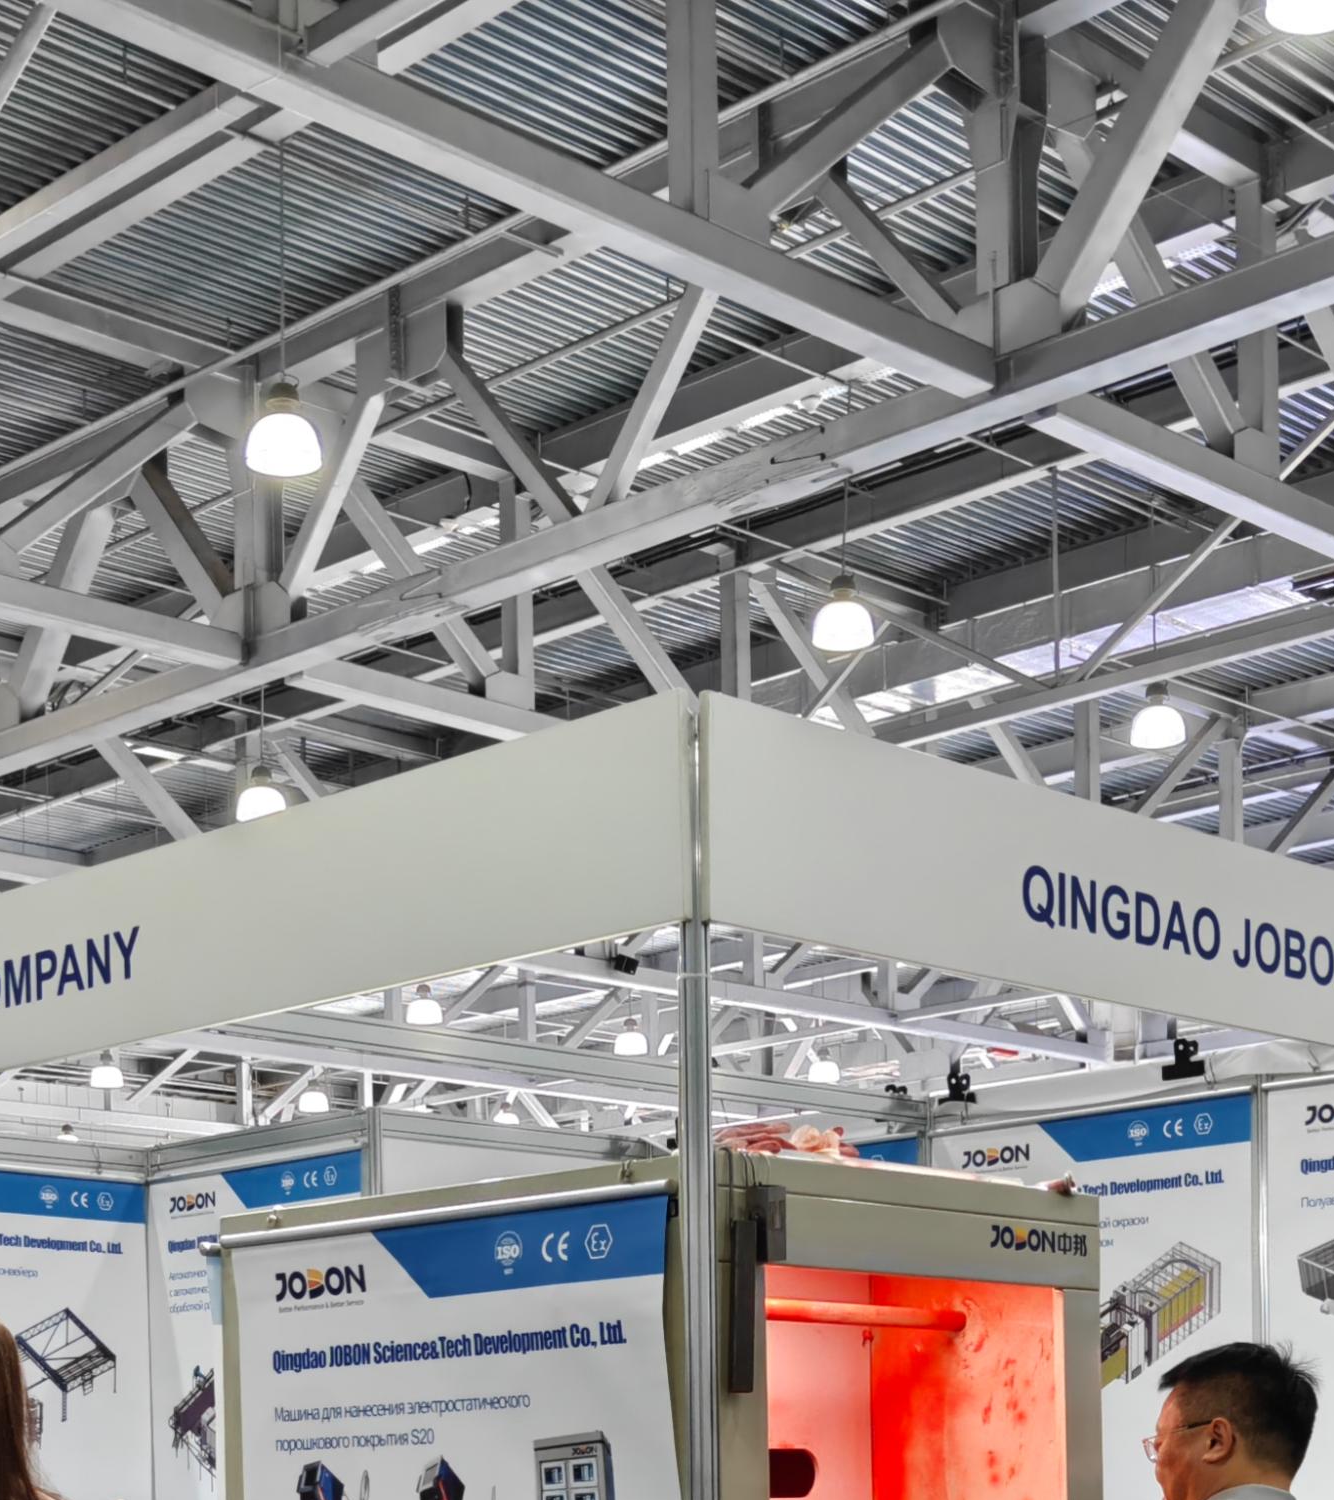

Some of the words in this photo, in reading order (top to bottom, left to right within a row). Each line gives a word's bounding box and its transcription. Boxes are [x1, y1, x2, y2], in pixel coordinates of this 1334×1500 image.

[1021, 864, 1221, 960] QINGDAO
[961, 1143, 1030, 1170] JOBON
[1109, 1174, 1183, 1197] Development
[1205, 1168, 1225, 1185] Ltd.
[169, 1191, 216, 1214] JOBON
[23, 1235, 89, 1253] Development
[496, 1243, 521, 1260] ISO
[541, 1232, 571, 1263] CE
[275, 1264, 367, 1302] JOBON
[273, 1348, 326, 1375] Qingdao
[328, 1342, 371, 1369] JOBON
[373, 1333, 473, 1366] Science&Tech
[473, 1324, 568, 1357] Development
[568, 1321, 597, 1349] Co.,
[599, 1318, 627, 1346] Ltd.
[274, 1404, 321, 1424] Машина
[321, 1404, 343, 1422] для
[343, 1398, 406, 1419] нанесения
[406, 1391, 531, 1418] электростатического
[275, 1433, 351, 1455] порошкового
[351, 1430, 409, 1450] покрытия
[410, 1427, 436, 1447] S20
